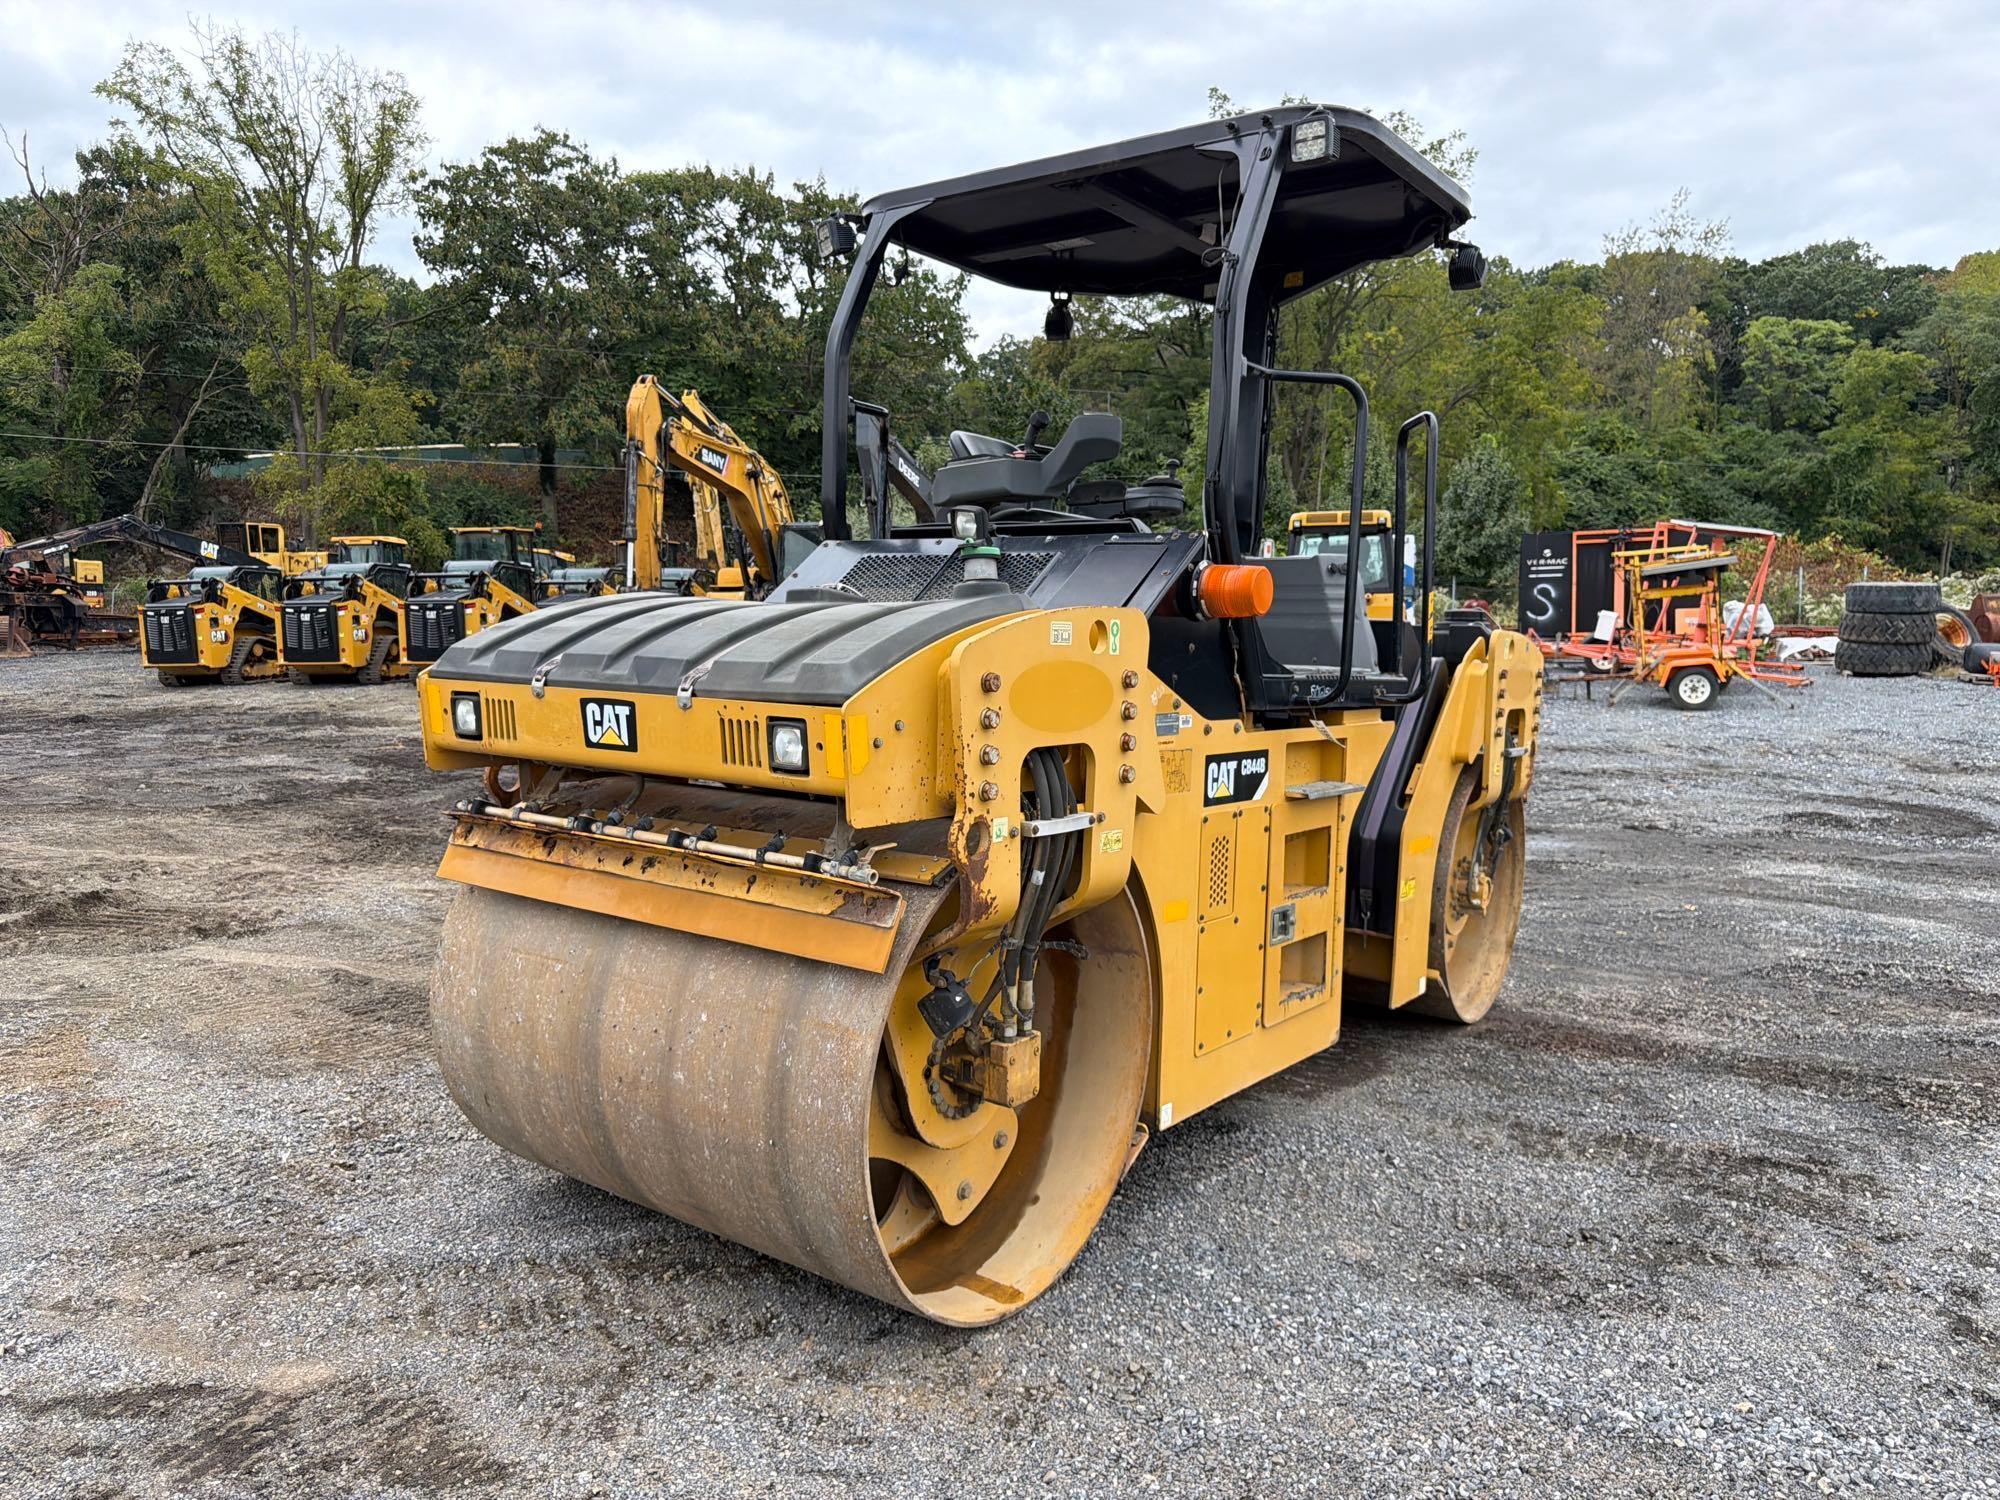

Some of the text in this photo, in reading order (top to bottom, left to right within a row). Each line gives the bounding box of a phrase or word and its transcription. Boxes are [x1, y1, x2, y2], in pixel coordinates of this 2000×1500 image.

[701, 446, 724, 470] SANY
[898, 456, 920, 488] DEERE
[200, 540, 220, 560] CAT
[1526, 583, 1556, 620] S
[211, 630, 226, 643] CAT
[353, 629, 367, 641] CAT
[585, 702, 630, 746] CAT
[1207, 761, 1238, 799] CAT
[1241, 757, 1266, 776] CB44B
